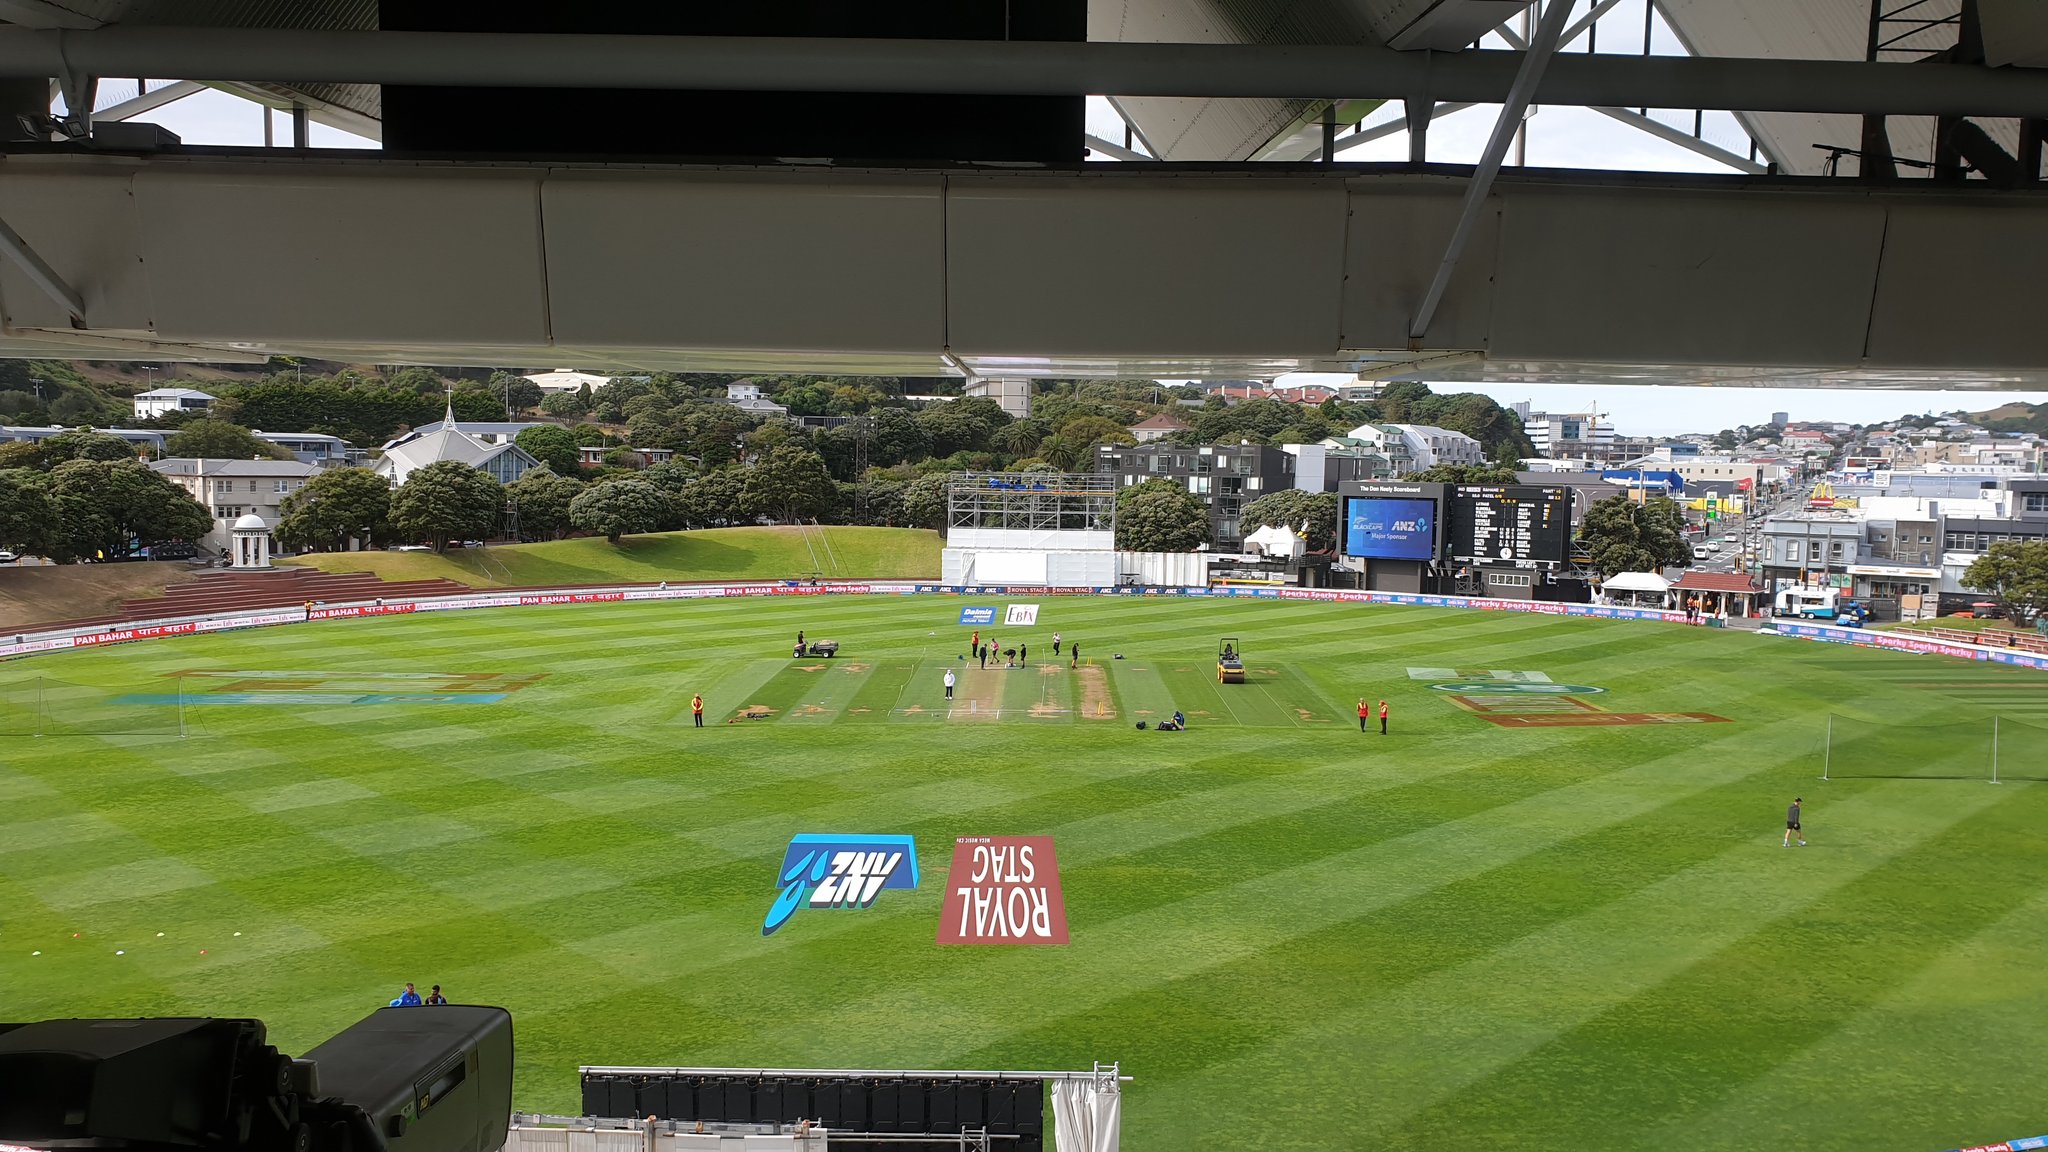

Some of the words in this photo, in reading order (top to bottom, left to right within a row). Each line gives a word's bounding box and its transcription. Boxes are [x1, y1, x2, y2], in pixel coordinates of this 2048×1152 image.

[1392, 520, 1415, 531] ANZ
[309, 609, 326, 619] PAN
[328, 607, 359, 617] BAHAR
[1470, 600, 1500, 608] Sparky
[1502, 602, 1532, 610] Sparky
[76, 636, 96, 645] PAN
[99, 631, 133, 642] BAHAR
[1877, 635, 1906, 646] Sparky
[1909, 640, 1938, 651] Sparky
[1940, 646, 1972, 658] Sparky
[971, 846, 1035, 883] STAG
[810, 852, 902, 903] ANZ
[956, 887, 1052, 938] ROYAL
